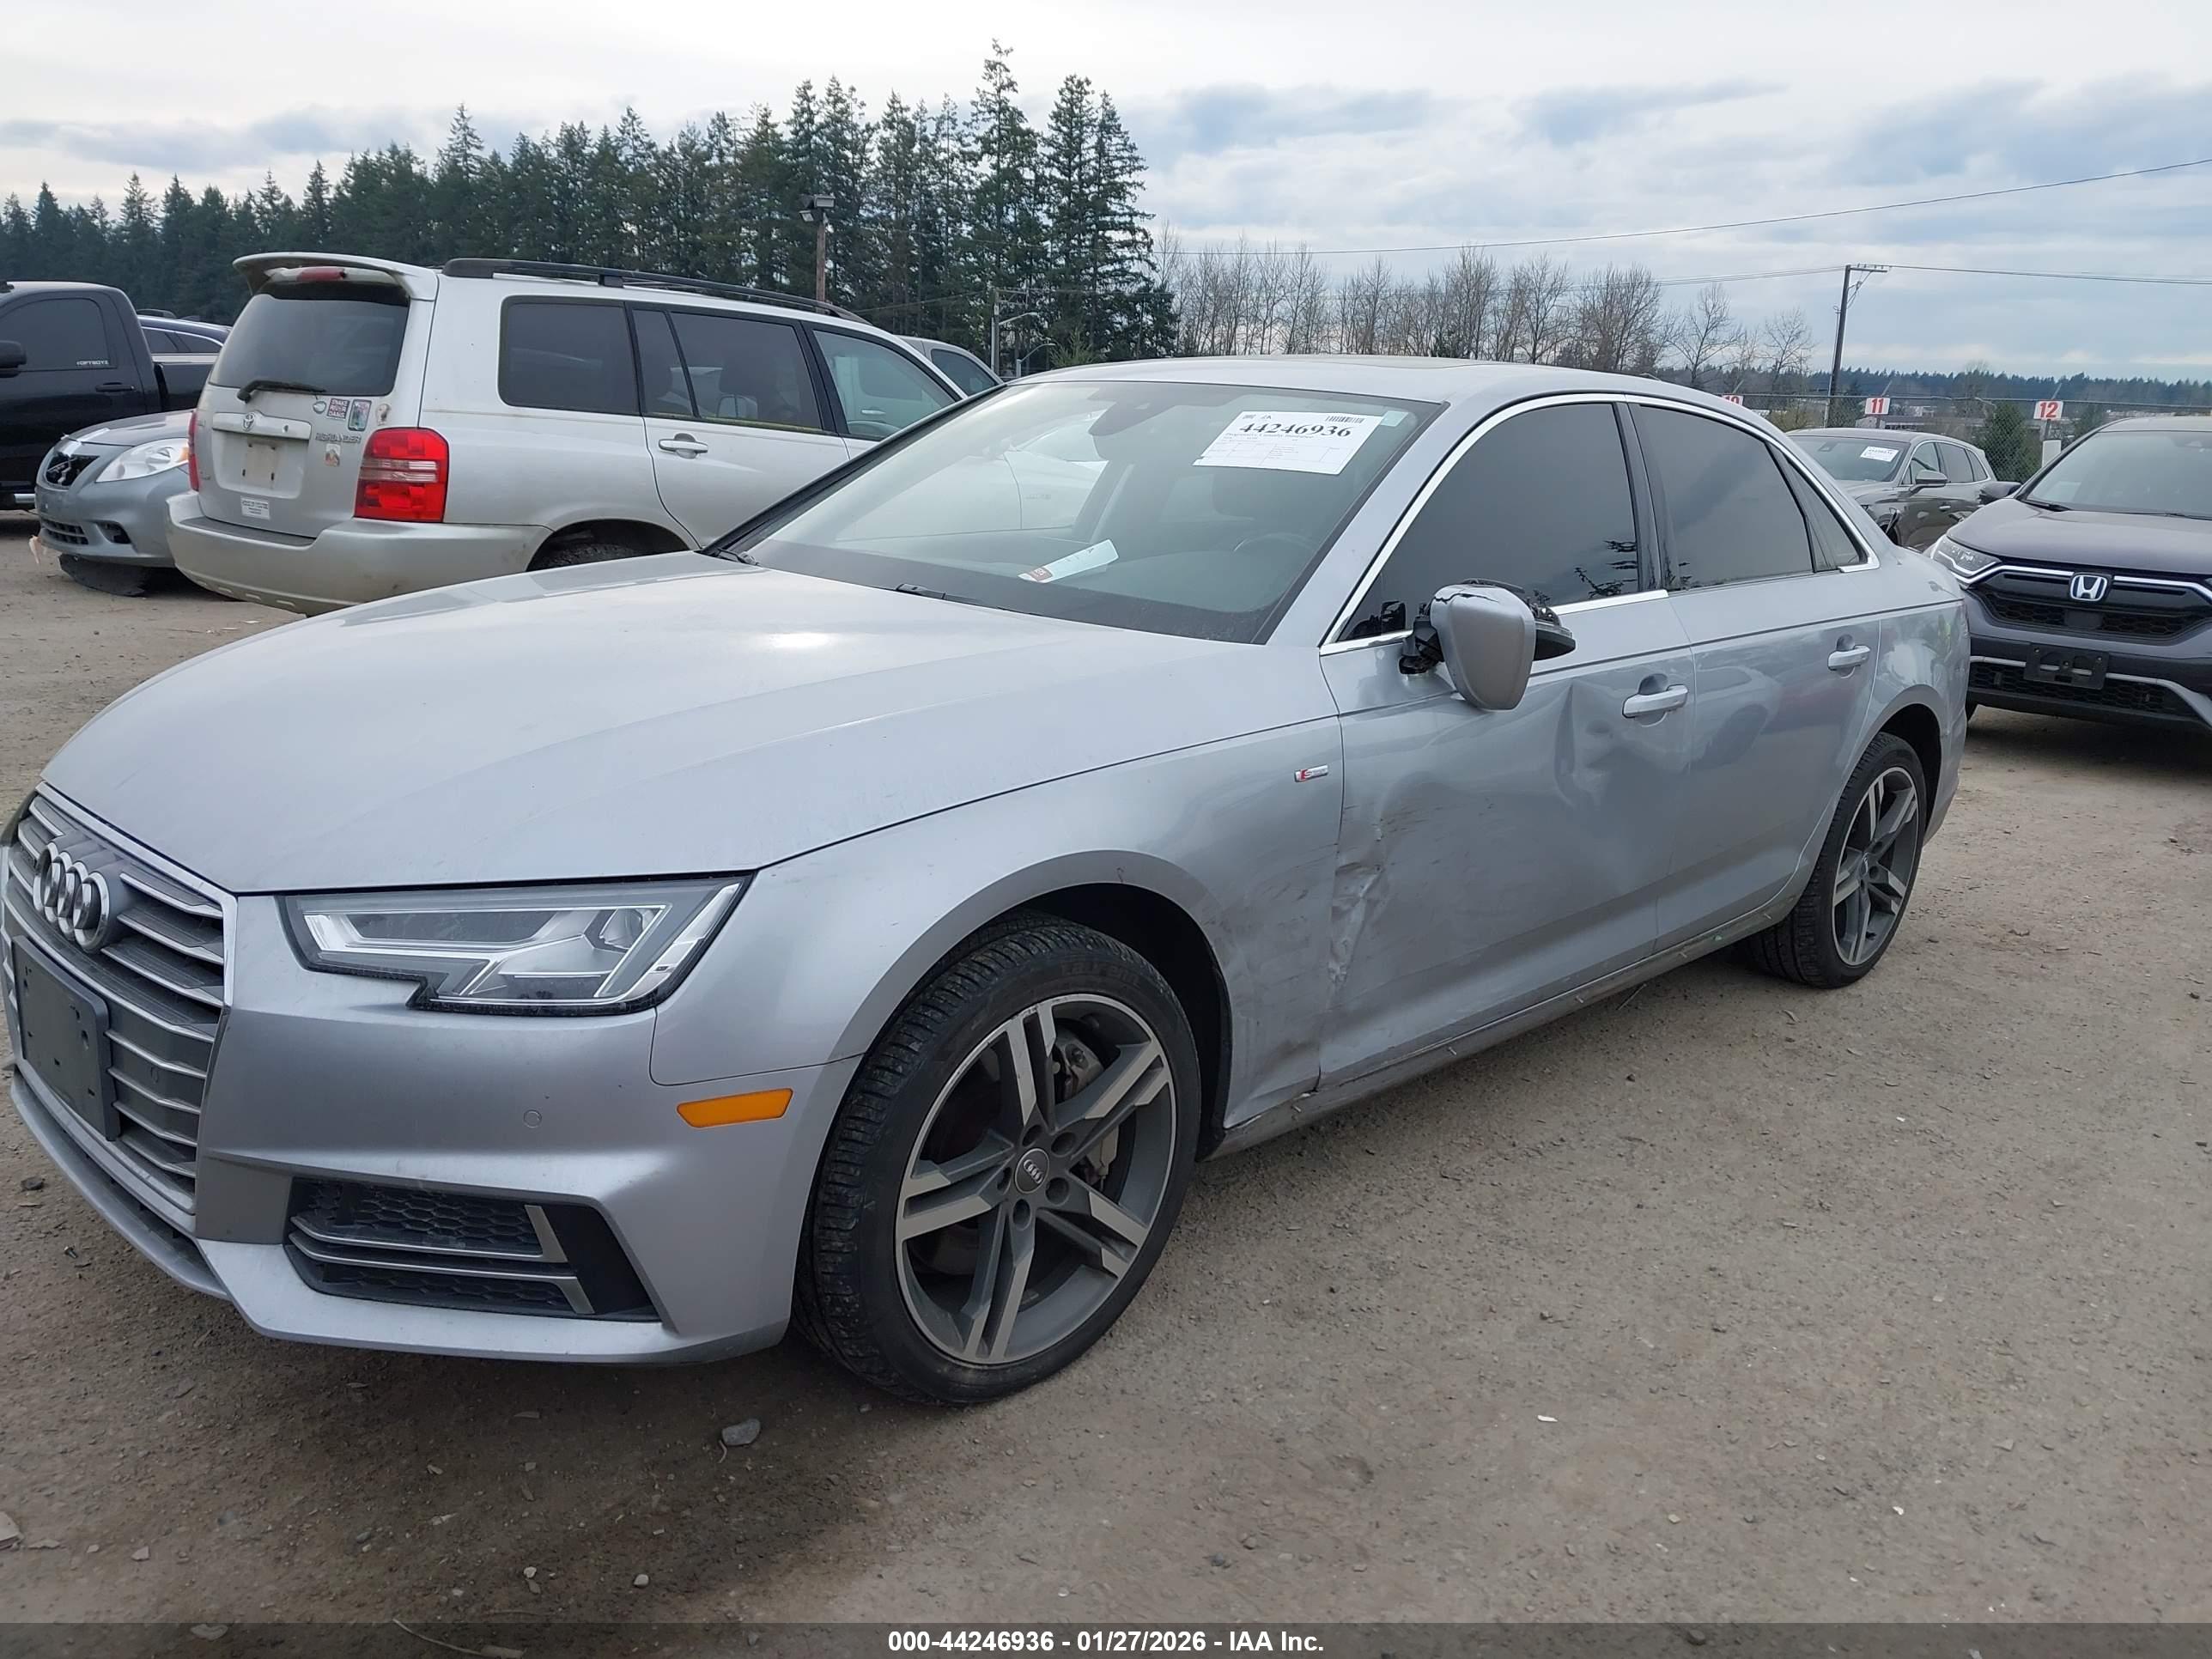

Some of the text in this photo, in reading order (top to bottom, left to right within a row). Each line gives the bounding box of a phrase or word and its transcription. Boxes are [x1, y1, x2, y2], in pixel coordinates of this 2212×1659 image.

[1871, 398, 1884, 414] 11
[2039, 402, 2059, 418] 12
[1239, 422, 1354, 438] 44246936
